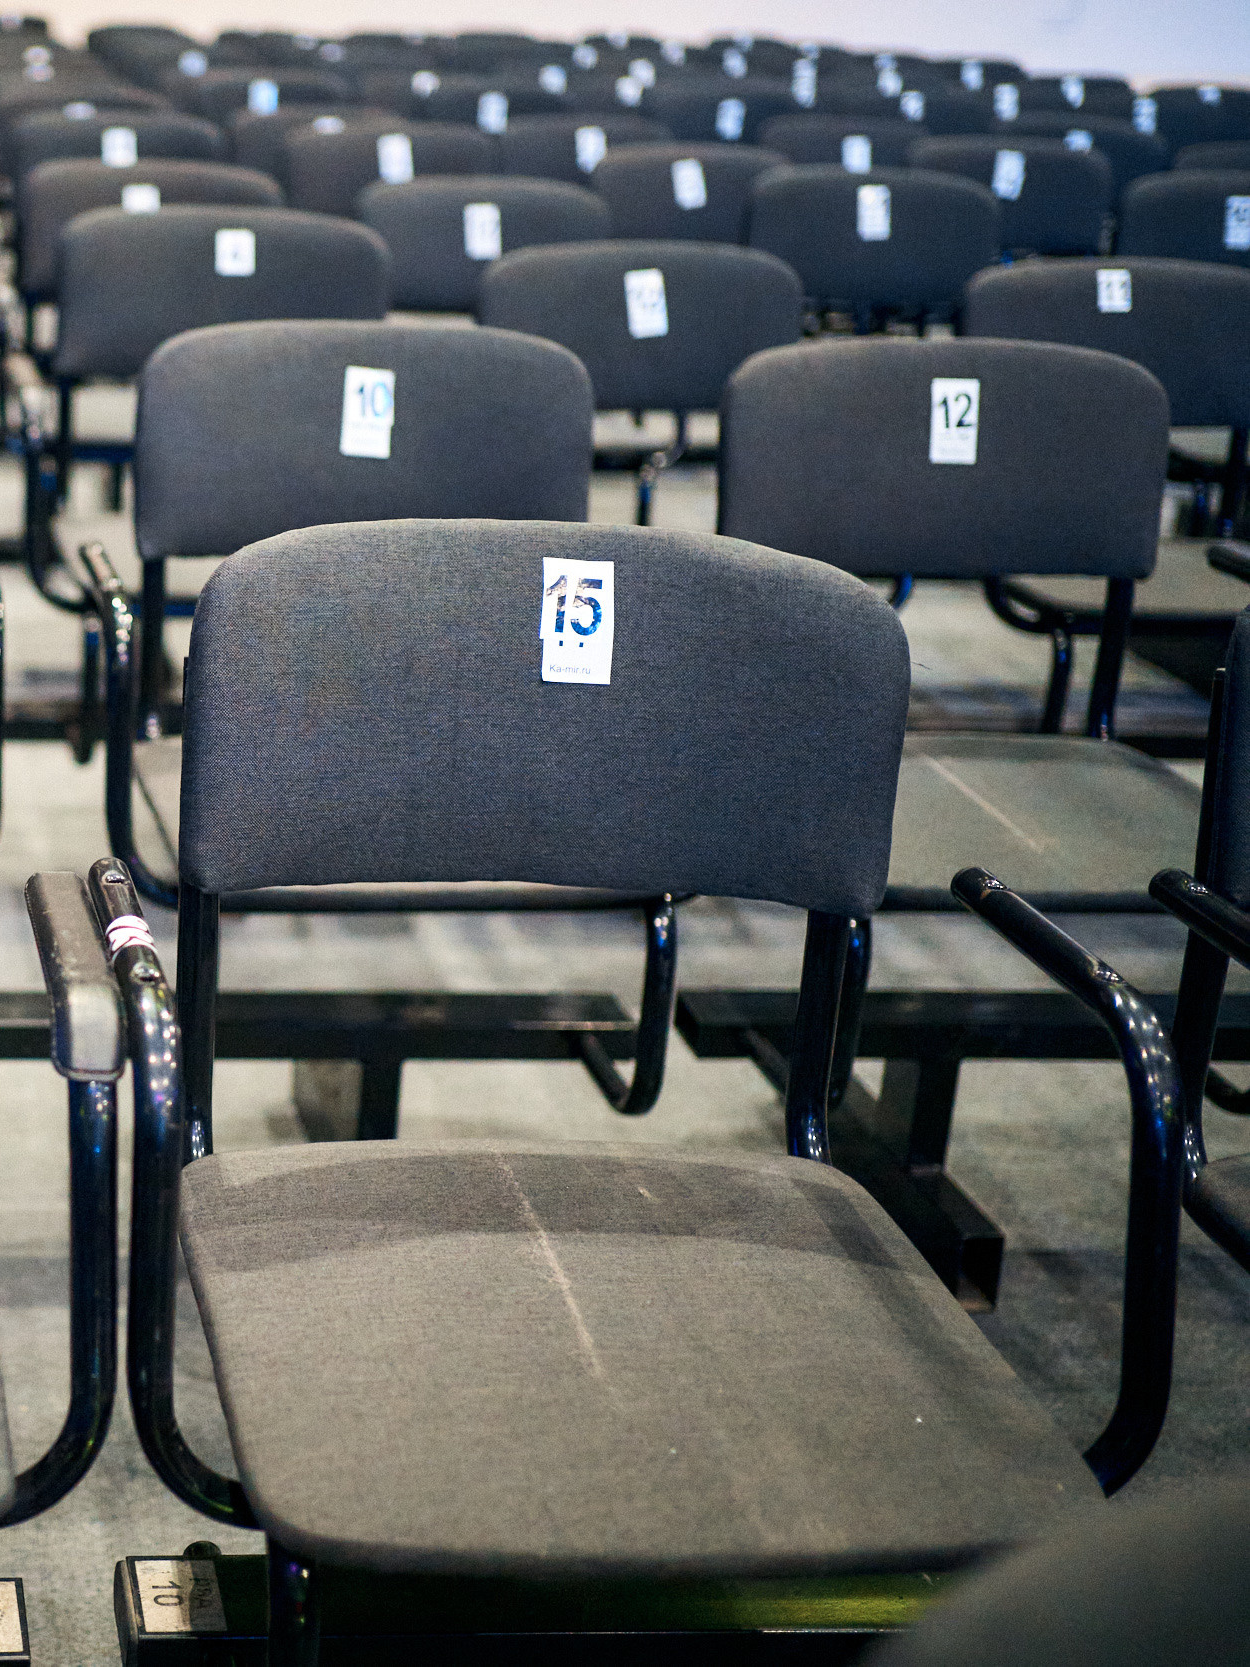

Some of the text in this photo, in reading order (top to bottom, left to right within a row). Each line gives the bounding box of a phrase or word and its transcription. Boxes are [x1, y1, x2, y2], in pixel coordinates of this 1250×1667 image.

[354, 381, 392, 418] 10
[937, 393, 973, 429] 12
[546, 575, 602, 636] 15
[152, 1580, 184, 1606] 10
